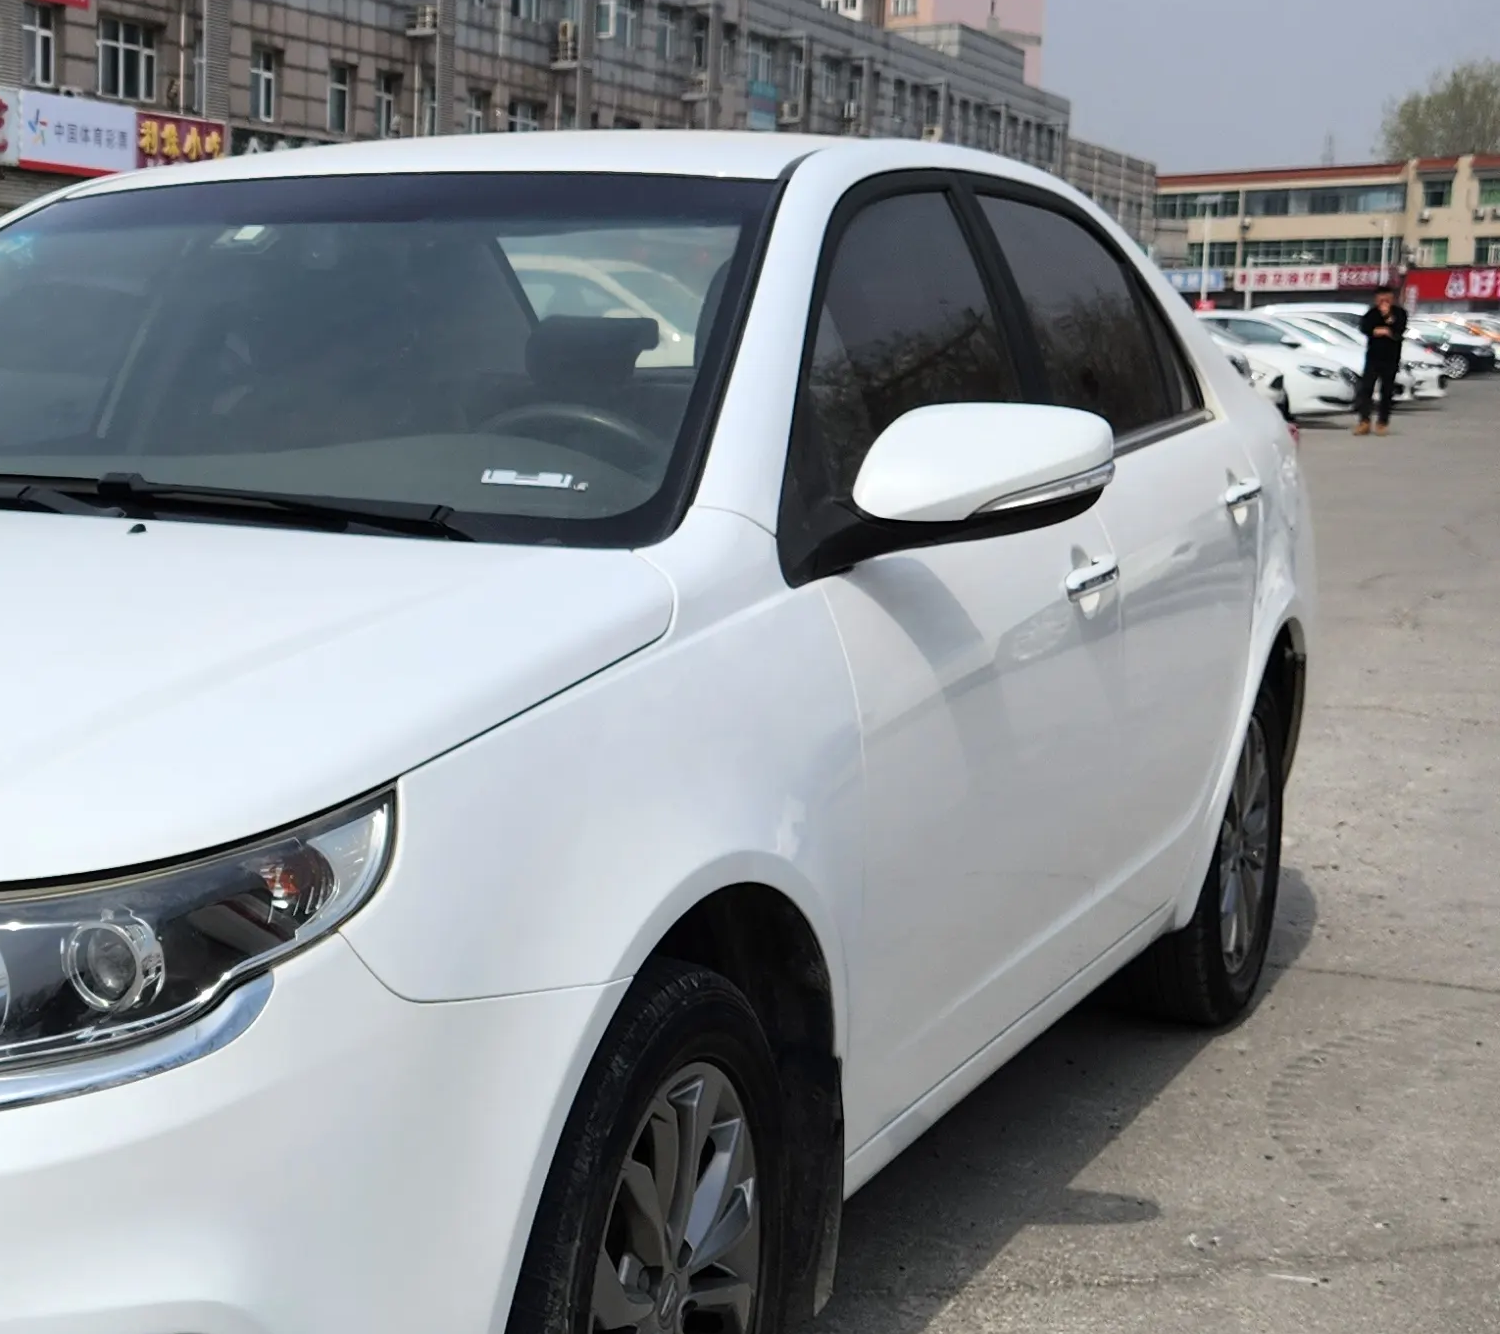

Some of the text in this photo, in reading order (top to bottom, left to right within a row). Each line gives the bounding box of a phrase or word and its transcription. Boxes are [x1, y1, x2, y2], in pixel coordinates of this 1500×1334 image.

[53, 122, 129, 150] 中国体育彩票
